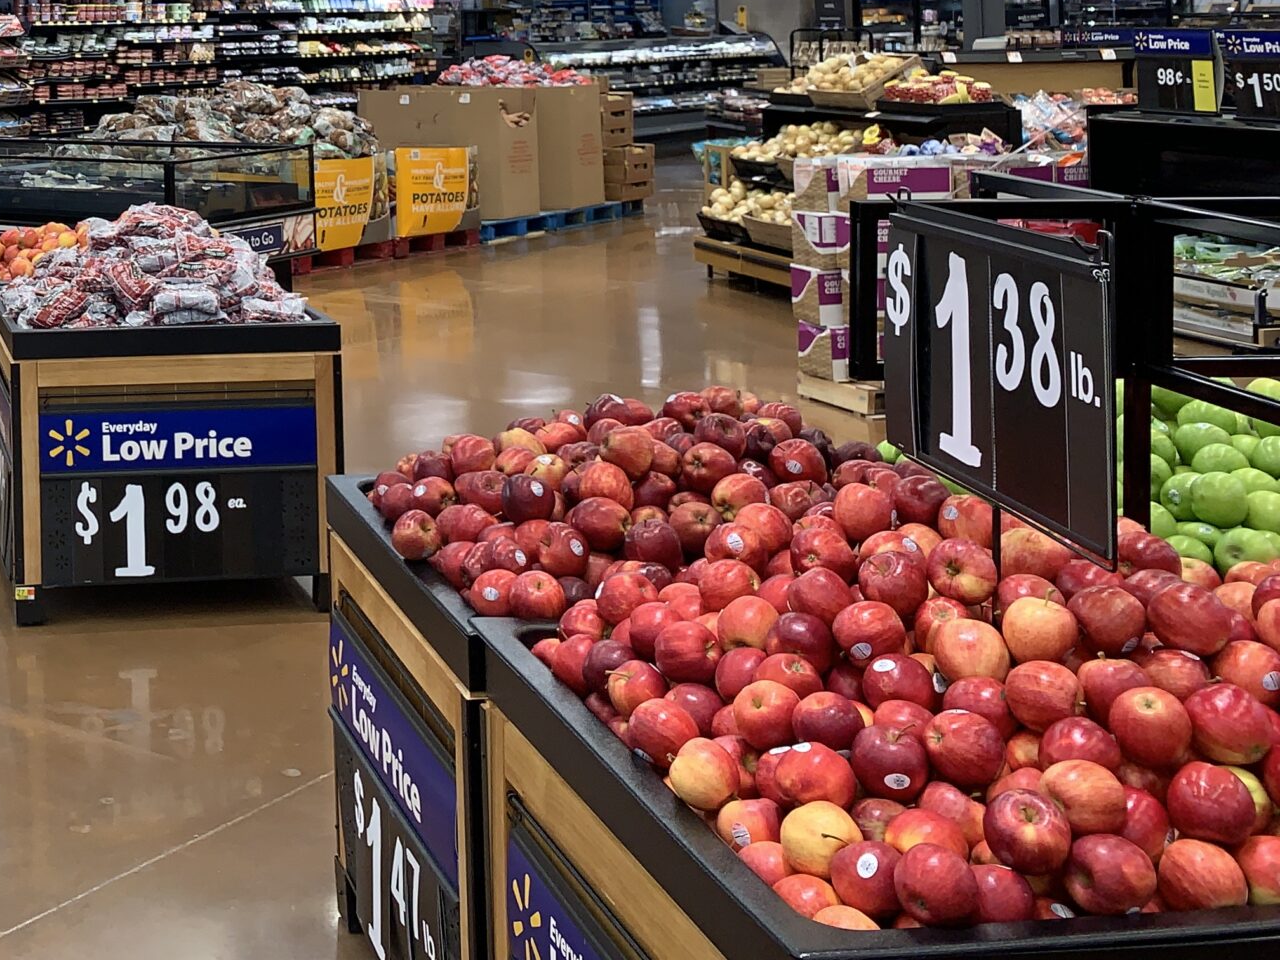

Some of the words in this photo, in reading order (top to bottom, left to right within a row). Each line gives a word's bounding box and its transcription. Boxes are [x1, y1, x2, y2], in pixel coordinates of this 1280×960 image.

[1149, 39, 1166, 49] Low
[1168, 39, 1190, 50] Price
[1243, 41, 1264, 53] Low
[1266, 42, 1280, 54] Pri
[1157, 68, 1183, 86] 98¢
[412, 191, 465, 204] POTATOES
[319, 203, 368, 218] OTATOES
[252, 238, 260, 247] to
[262, 231, 274, 245] Go
[1070, 351, 1101, 408] lb.
[102, 420, 157, 435] Everyday
[102, 435, 167, 462] Low
[174, 430, 252, 459] Price
[228, 496, 247, 509] ea.
[352, 665, 377, 713] Everyday
[351, 684, 379, 761] Low
[381, 727, 422, 824] Price
